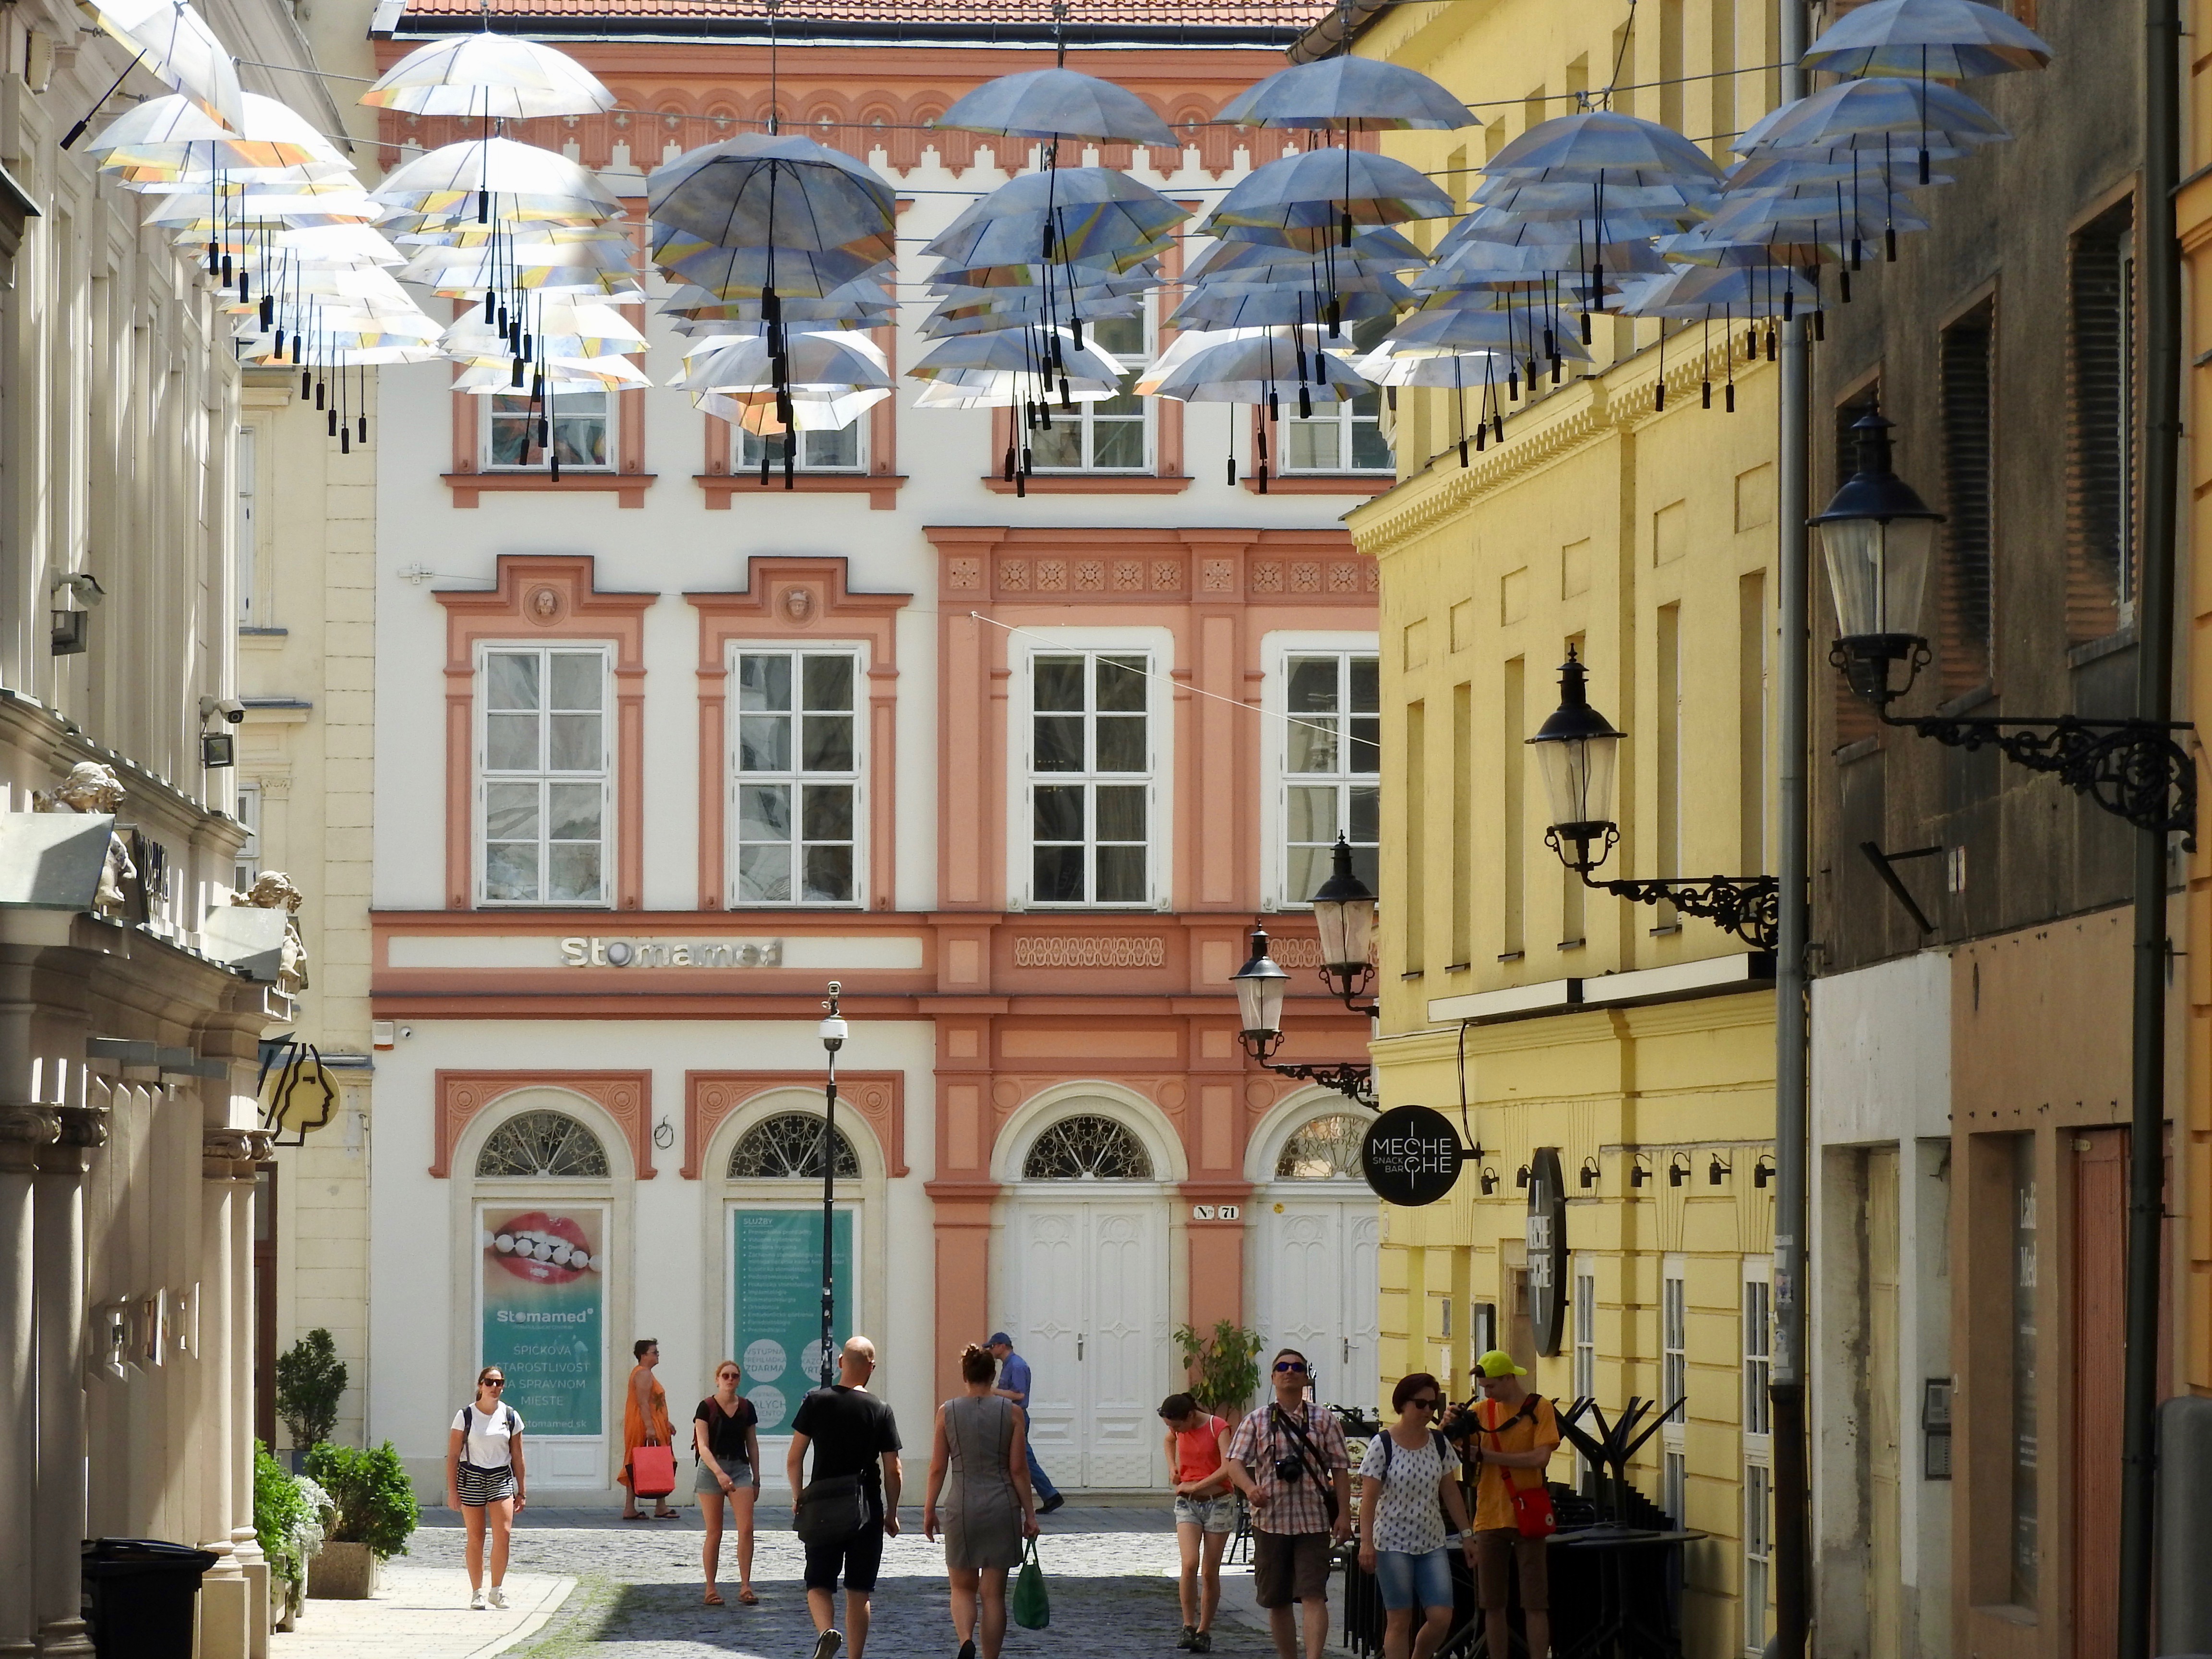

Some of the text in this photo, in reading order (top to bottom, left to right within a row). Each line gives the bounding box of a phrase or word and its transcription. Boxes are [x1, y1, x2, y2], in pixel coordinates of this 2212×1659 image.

[561, 938, 782, 966] Stomamed
[1373, 1138, 1452, 1155] MECHE
[1372, 1156, 1404, 1165] SNACK
[1222, 1207, 1234, 1218] 71
[497, 1310, 586, 1323] Stomamed
[521, 1395, 565, 1406] MIESTE
